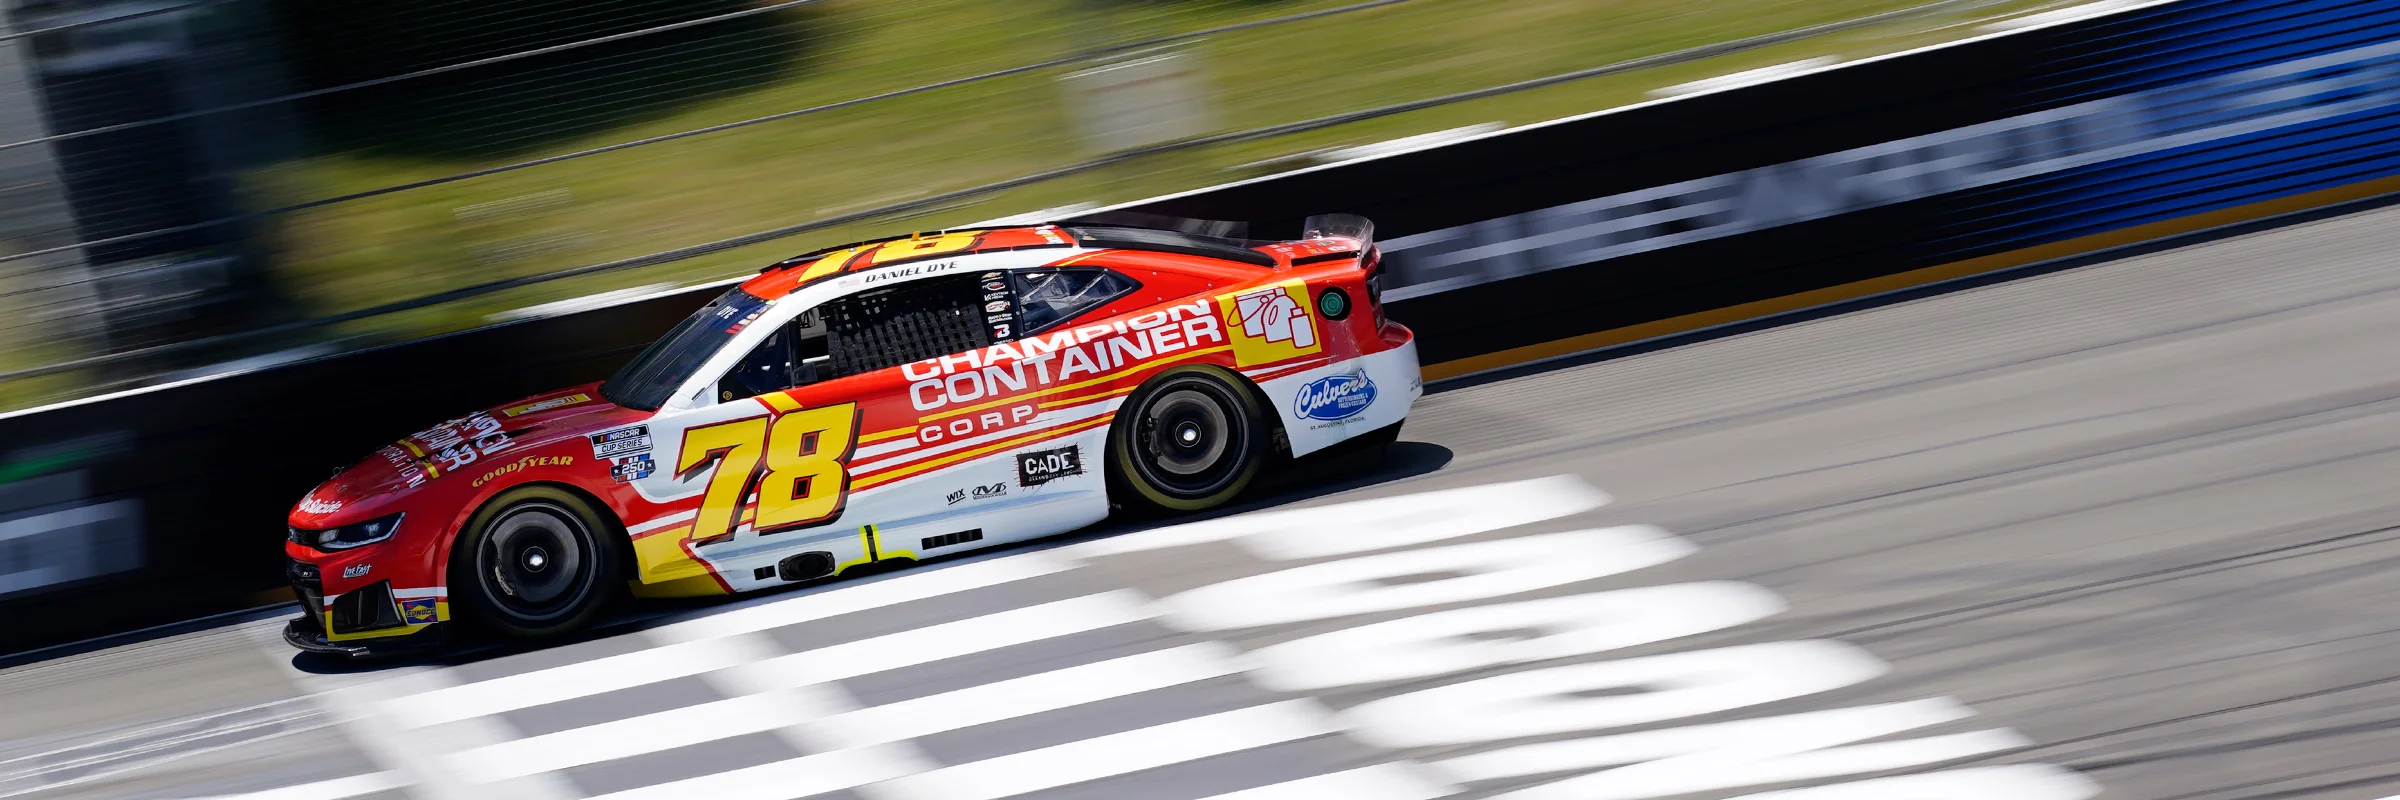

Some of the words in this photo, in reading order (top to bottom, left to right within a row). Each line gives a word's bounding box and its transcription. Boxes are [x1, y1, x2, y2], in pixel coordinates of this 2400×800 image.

[865, 267, 922, 283] DANIEL
[927, 261, 959, 273] DYE
[901, 299, 1211, 382] CHAMPION
[910, 315, 1223, 411] CONTAINER
[610, 428, 640, 441] NASCAR
[920, 404, 1034, 443] CORP
[602, 443, 616, 453] CUP
[617, 438, 643, 450] SERIES
[472, 455, 574, 488] GOODYEAR
[622, 461, 646, 475] 250
[673, 401, 864, 547] 78
[1024, 452, 1075, 475] CADE
[946, 488, 966, 503] WIX
[407, 608, 436, 618] SUNOCO
